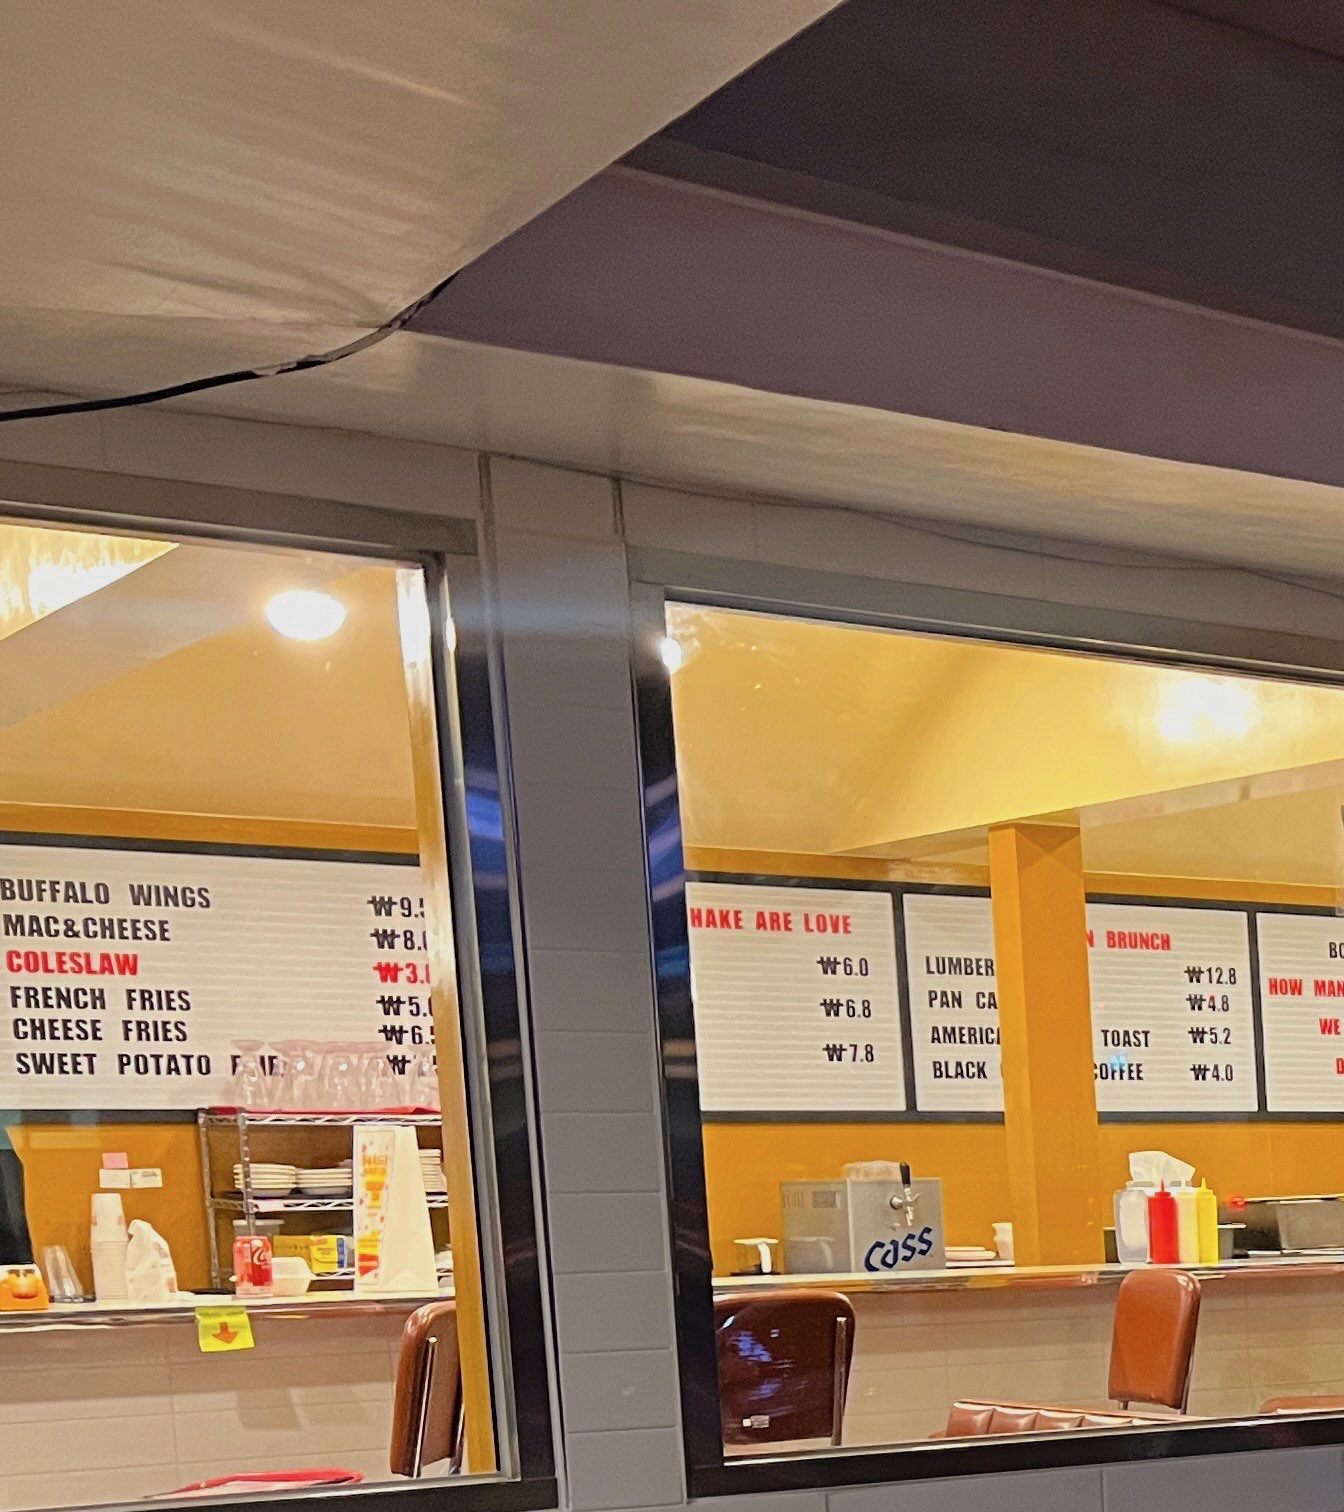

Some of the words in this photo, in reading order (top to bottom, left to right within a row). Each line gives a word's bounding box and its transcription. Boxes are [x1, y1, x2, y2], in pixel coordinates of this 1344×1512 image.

[0, 878, 110, 905] BUFFALO
[129, 883, 211, 909] WINGS
[3, 914, 171, 942] MAC&CHEESE
[756, 911, 793, 932] ARE
[804, 913, 852, 935] LOVE
[1106, 931, 1171, 951] BRUNCH
[6, 949, 140, 976] COLESLAW
[925, 956, 995, 977] LUMBER
[1268, 978, 1303, 997] HOW
[10, 986, 106, 1010] FRENCH
[125, 989, 192, 1012] FRIES
[928, 989, 963, 1009] PAN
[13, 1018, 103, 1042] CHEESE
[122, 1020, 188, 1042] FRIES
[1319, 1018, 1341, 1036] WE
[1101, 1029, 1151, 1048] TOAST
[16, 1052, 97, 1076] SWEET
[118, 1053, 211, 1077] POTATO
[933, 1061, 988, 1080] BLACK
